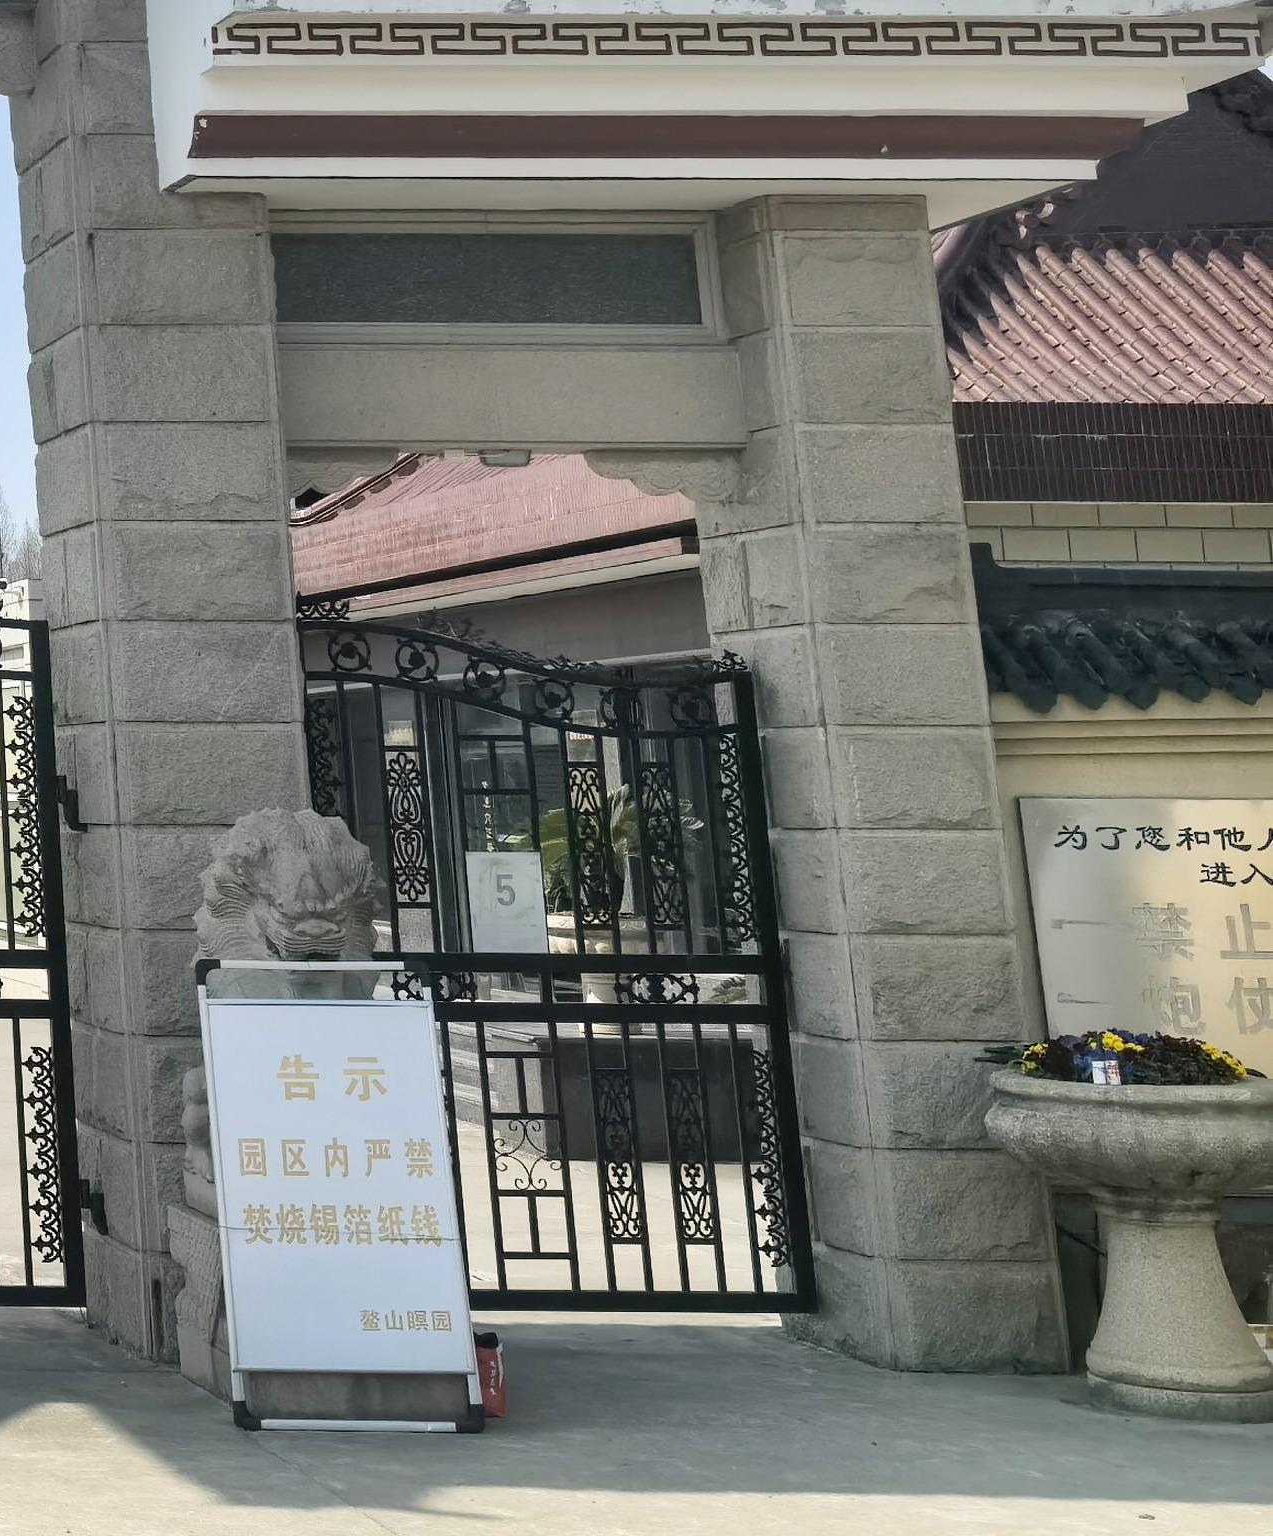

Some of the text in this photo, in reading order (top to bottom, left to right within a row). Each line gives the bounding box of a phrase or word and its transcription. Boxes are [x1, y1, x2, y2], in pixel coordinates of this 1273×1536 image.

[496, 874, 516, 906] 5
[276, 1054, 388, 1102] 告示
[237, 1137, 434, 1179] 园区内严禁
[242, 1204, 442, 1247] 焚烧锡箔纸钱
